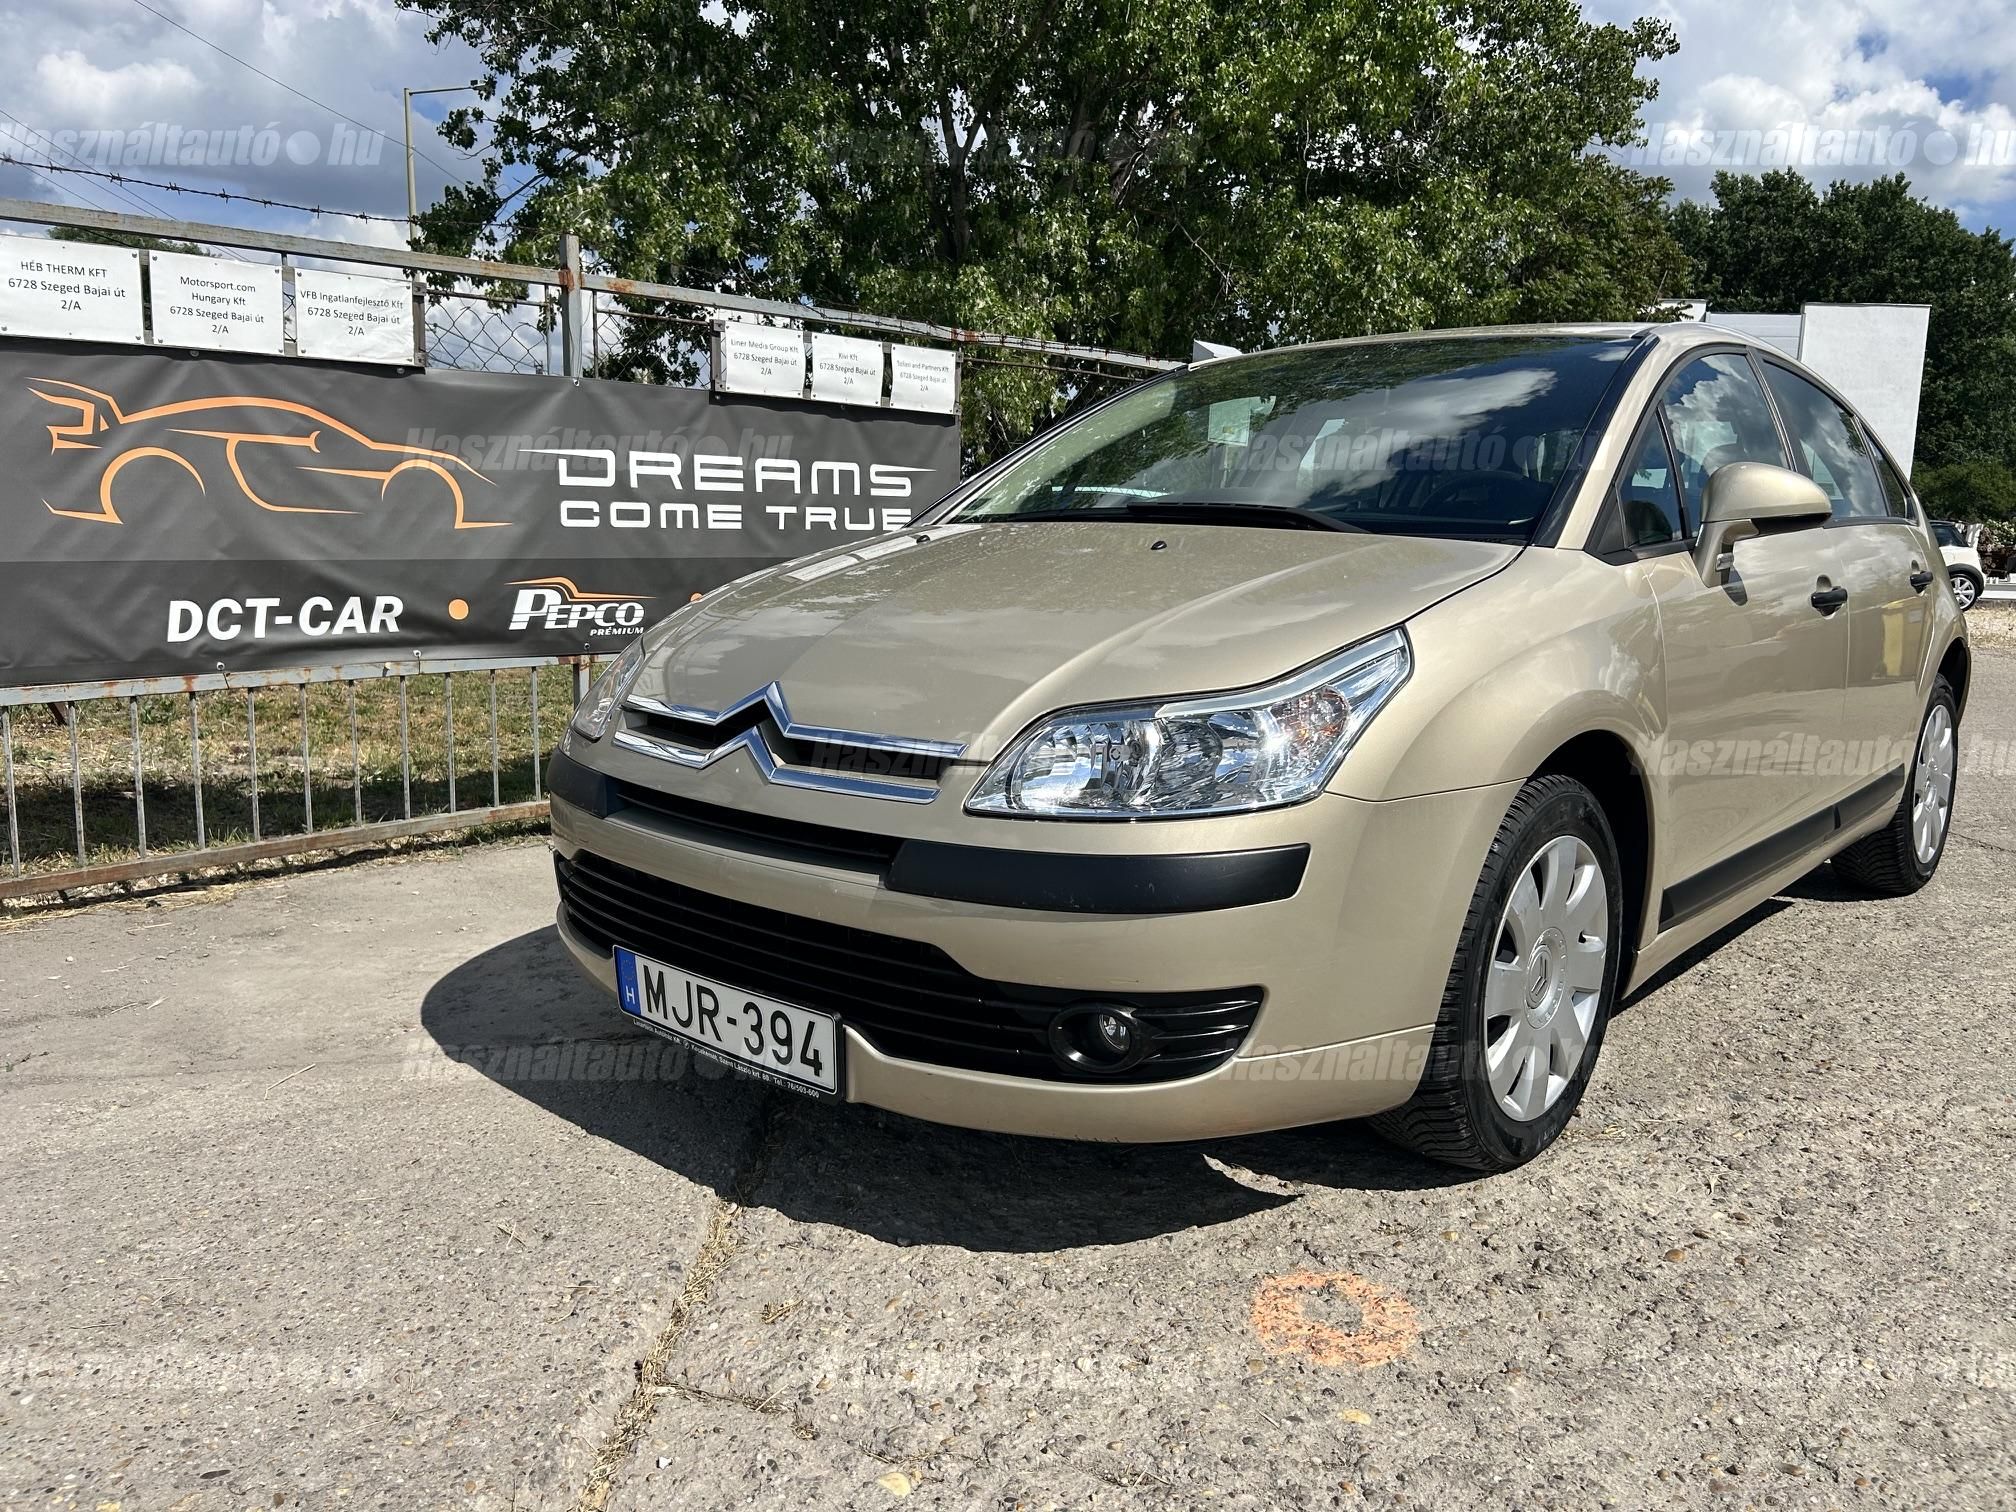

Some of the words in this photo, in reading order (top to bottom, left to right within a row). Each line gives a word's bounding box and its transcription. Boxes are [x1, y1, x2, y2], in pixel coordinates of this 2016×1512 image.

[20, 260, 43, 272] HÉB
[45, 263, 85, 276] THERM
[88, 267, 108, 278] KFT
[8, 277, 38, 290] 6728
[40, 280, 80, 294] Szeged
[83, 284, 111, 297] Bajai
[113, 287, 126, 298] út
[180, 276, 256, 293] Motorsport.com
[60, 299, 82, 311] 2/A
[191, 292, 231, 306] Hungary
[233, 296, 246, 306] Kft
[300, 290, 317, 300] VFB
[319, 292, 390, 309] Ingatlanfejlesztő
[391, 299, 404, 309] Kft
[169, 305, 194, 316] 6728
[195, 308, 228, 321] Szeged
[231, 312, 253, 324] Bajai
[307, 306, 331, 318] 6728
[333, 309, 364, 322] Szeged
[366, 312, 389, 325] Bajai
[211, 324, 229, 335] 2/A
[348, 325, 365, 337] 2/A
[733, 352, 750, 361] 6728
[751, 353, 773, 364] Szeged
[760, 367, 773, 376] 2/A
[819, 362, 835, 372] 6728
[834, 364, 855, 374] Szeged
[843, 376, 854, 386] 2/A
[530, 449, 926, 498] DREAMS
[560, 500, 742, 530] COME
[765, 505, 912, 531] TRUE
[509, 588, 645, 630] PEPCO
[166, 595, 402, 642] DCT-CAR
[590, 626, 644, 637] PRÉMIUM
[624, 984, 636, 1005] H
[643, 964, 823, 1078] MJR-394
